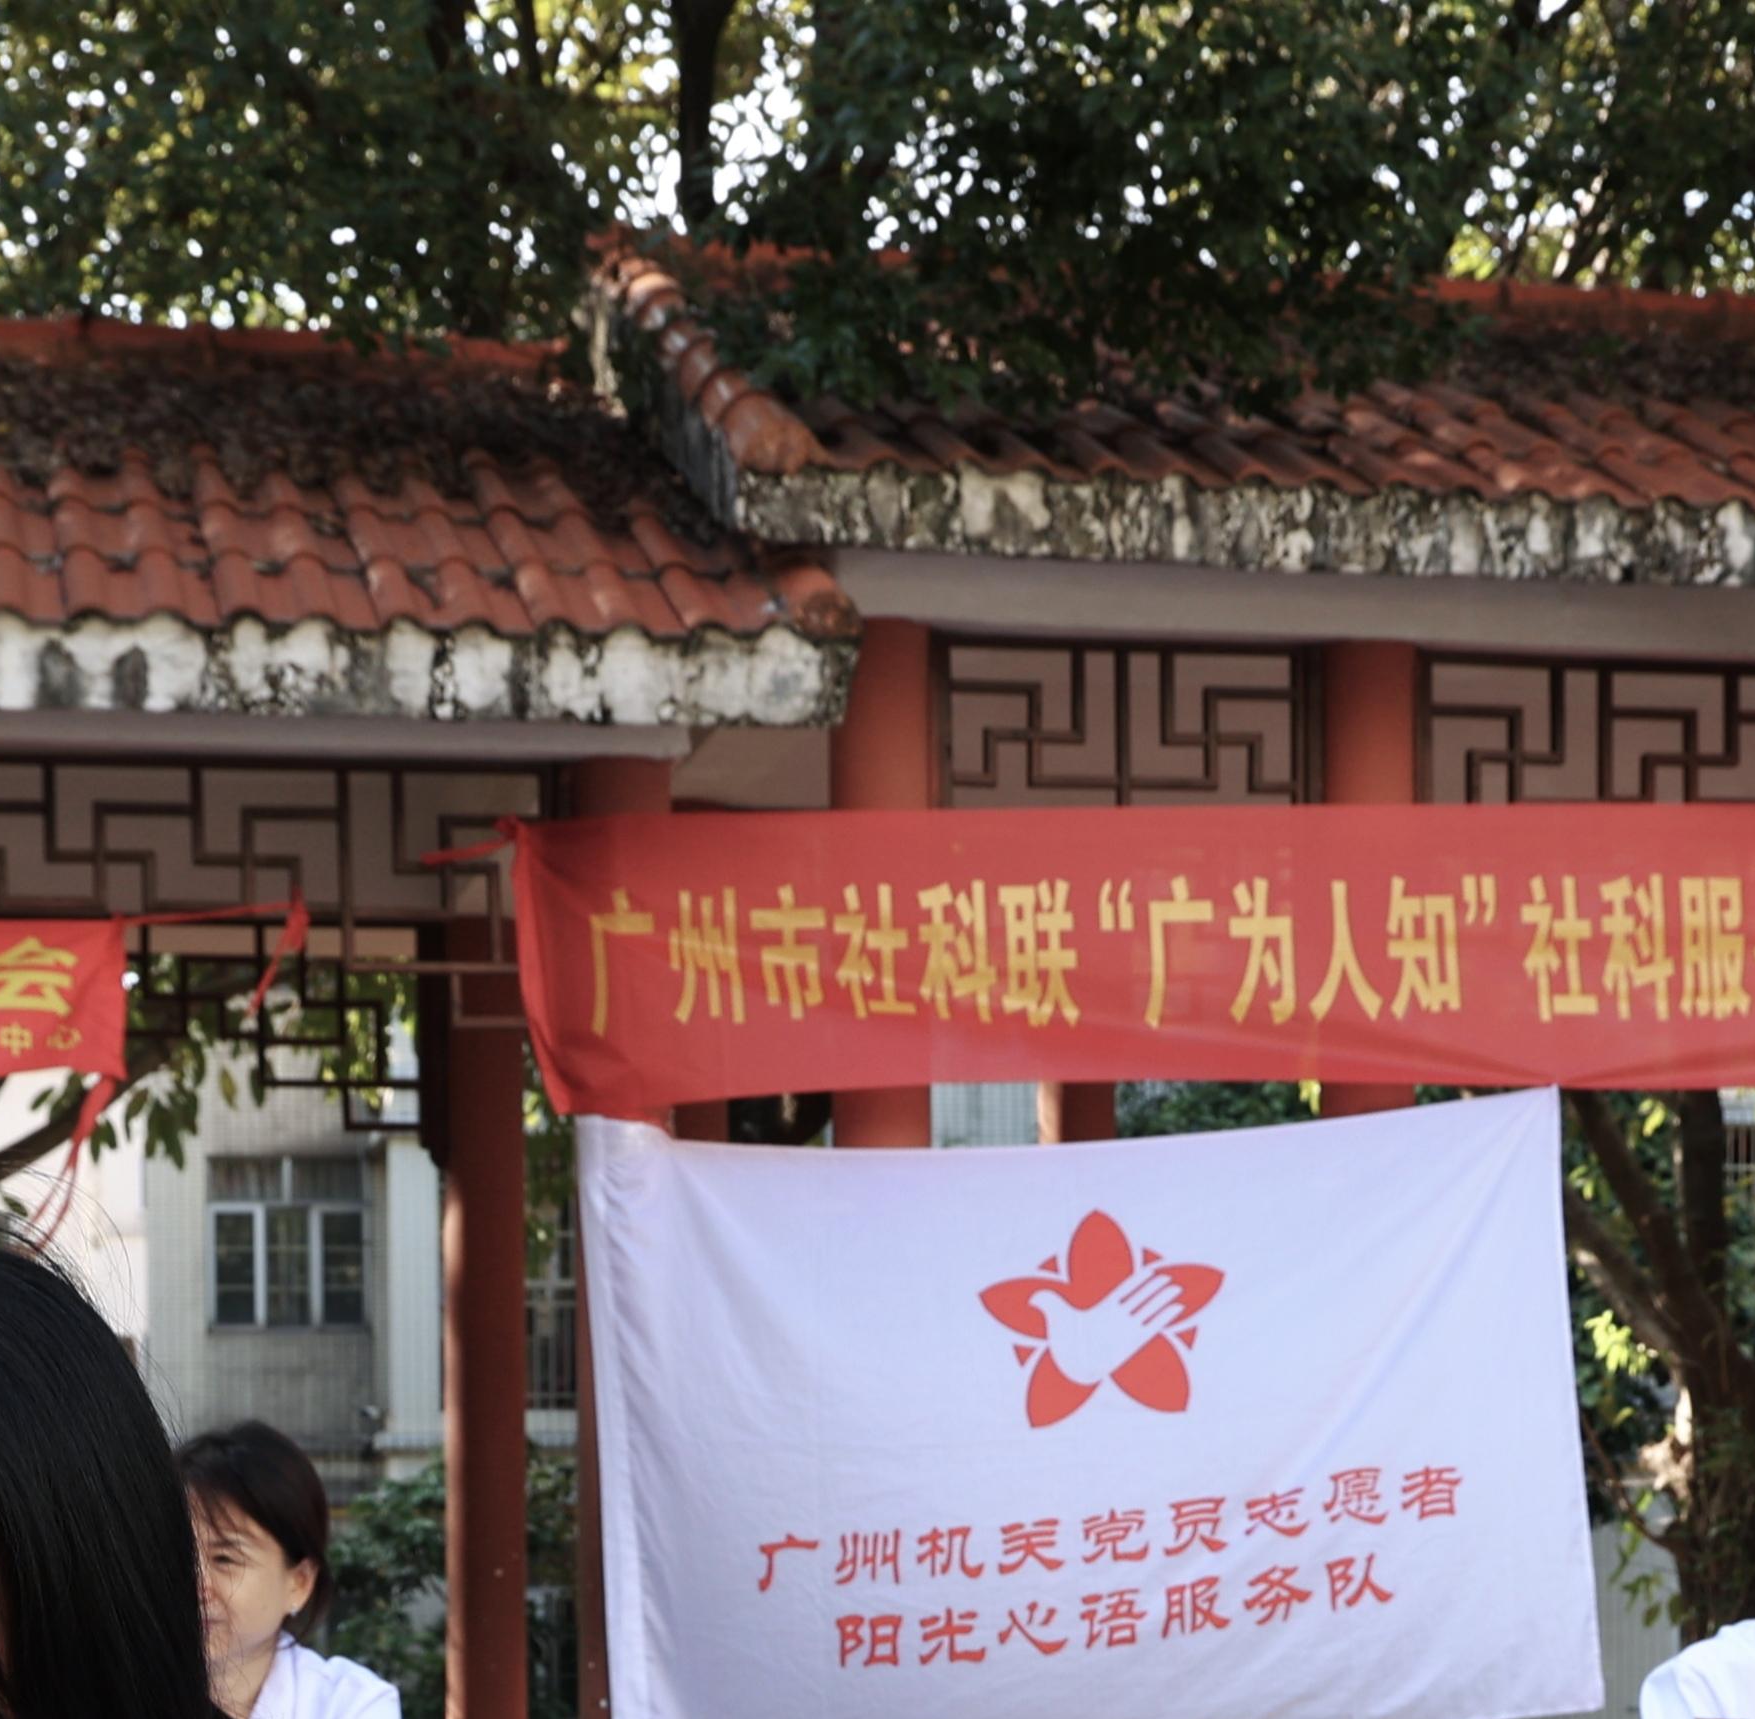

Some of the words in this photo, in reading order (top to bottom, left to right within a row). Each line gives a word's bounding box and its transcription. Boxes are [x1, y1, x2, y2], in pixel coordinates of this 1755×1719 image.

[757, 1464, 1464, 1594] 广州机关党员志愿者
[836, 1554, 1395, 1669] 阳光心语服务队
